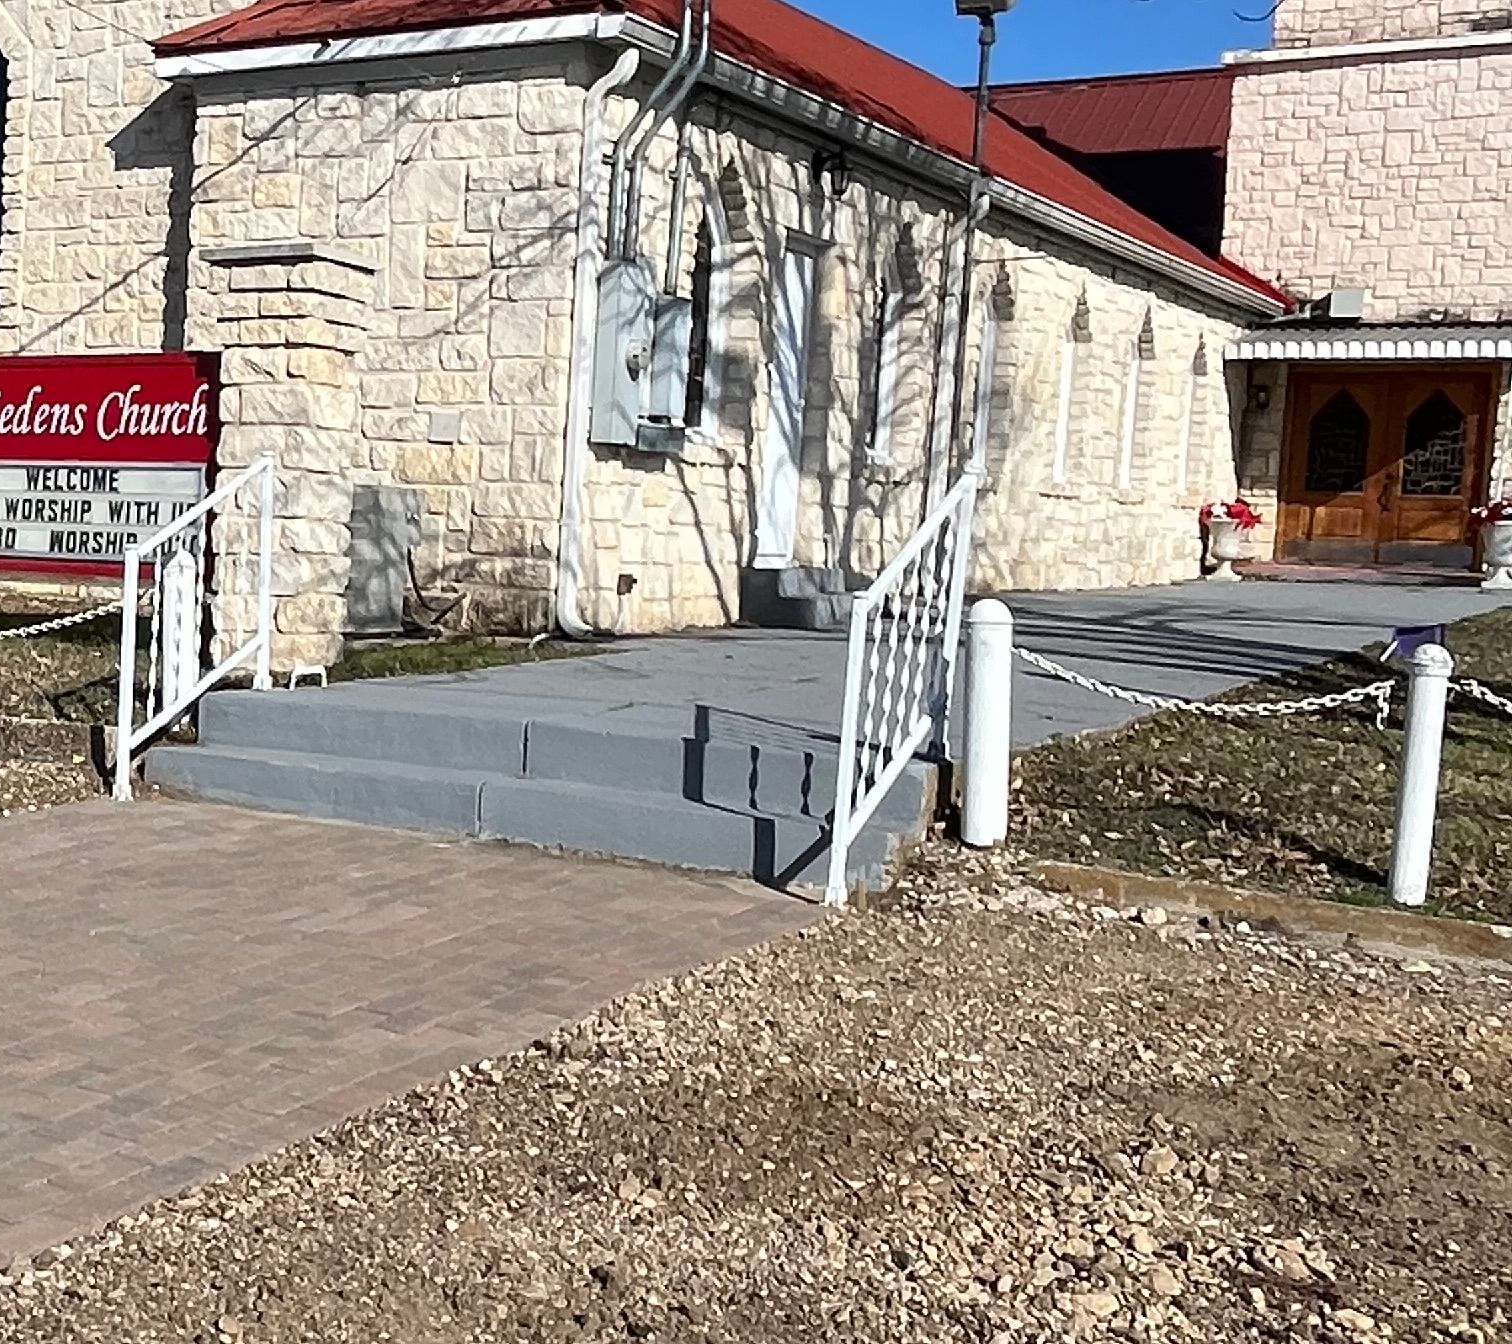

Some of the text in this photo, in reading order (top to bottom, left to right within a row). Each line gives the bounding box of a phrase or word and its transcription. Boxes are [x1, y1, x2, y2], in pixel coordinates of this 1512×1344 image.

[97, 383, 209, 441] Church
[26, 468, 120, 492] WELCOME
[5, 497, 92, 523] WORSHIP
[108, 500, 160, 525] WITH
[171, 501, 198, 523] U
